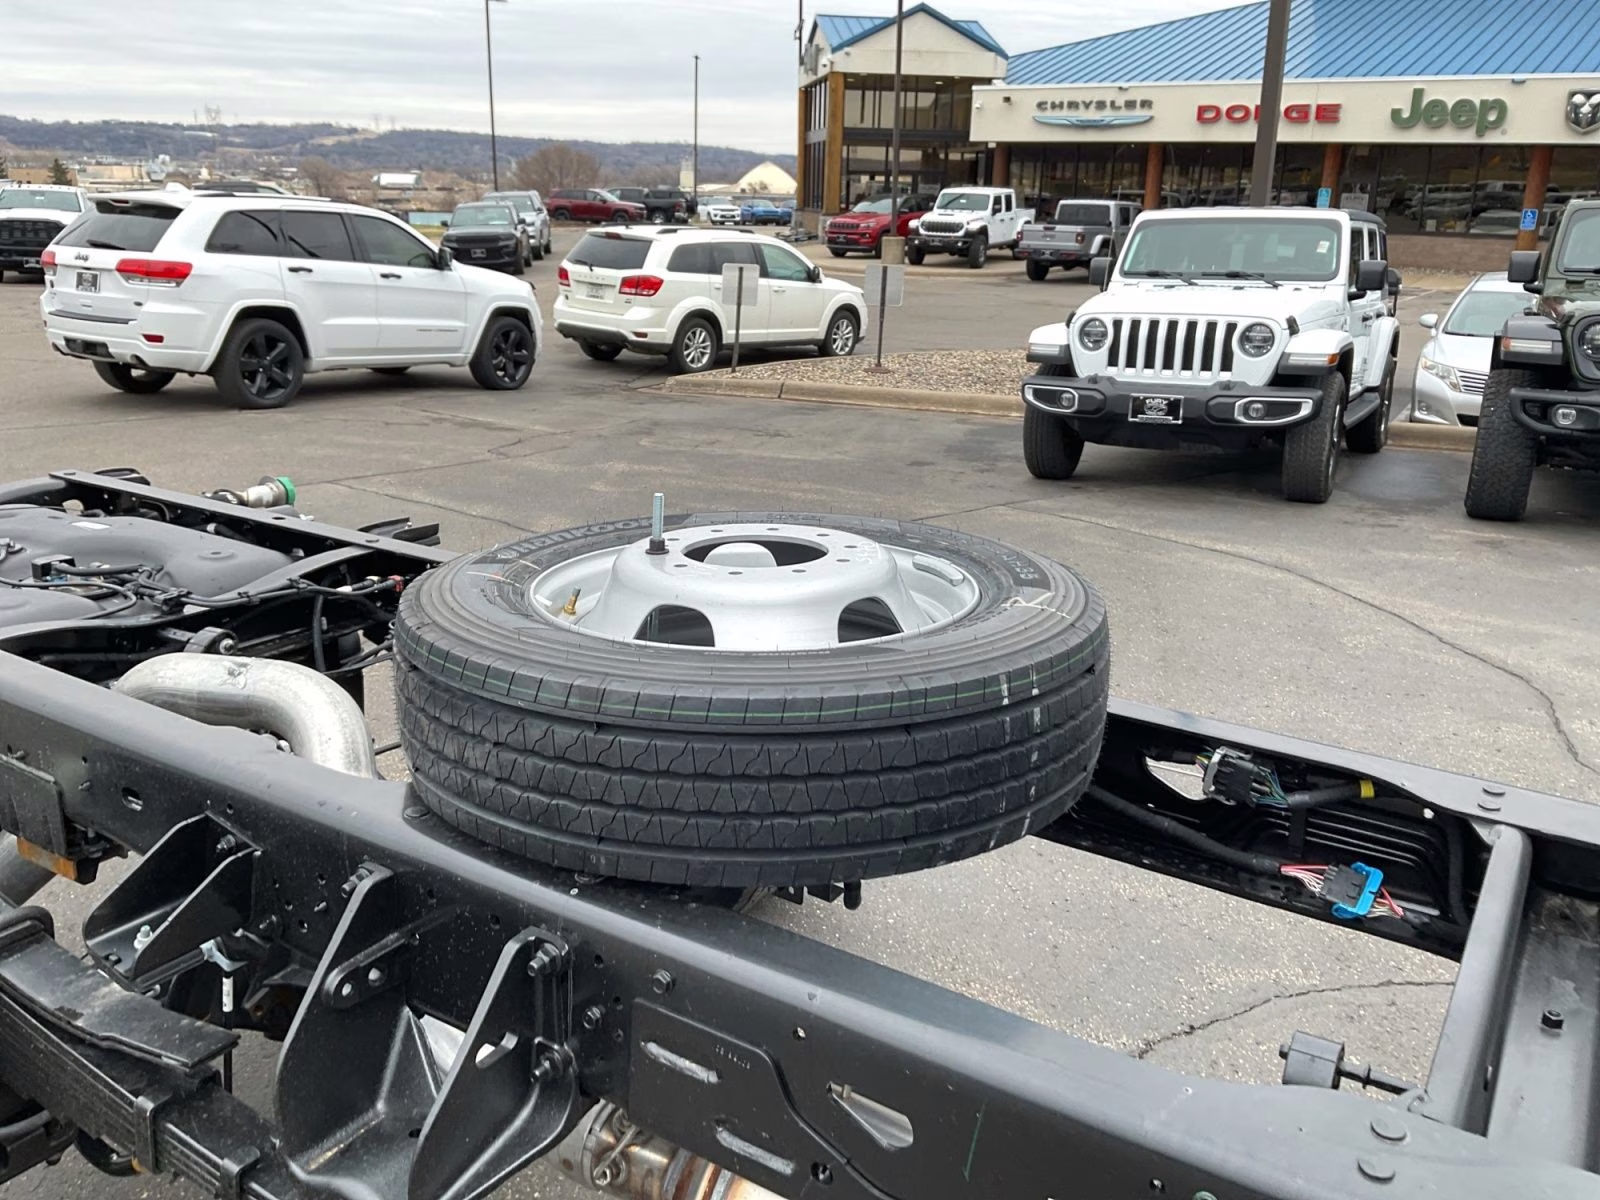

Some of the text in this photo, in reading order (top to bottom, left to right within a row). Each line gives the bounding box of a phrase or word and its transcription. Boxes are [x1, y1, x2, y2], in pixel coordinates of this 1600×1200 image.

[1036, 99, 1153, 111] CHRYSLER
[1196, 104, 1342, 123] DOGE
[1391, 88, 1508, 137] Jeep
